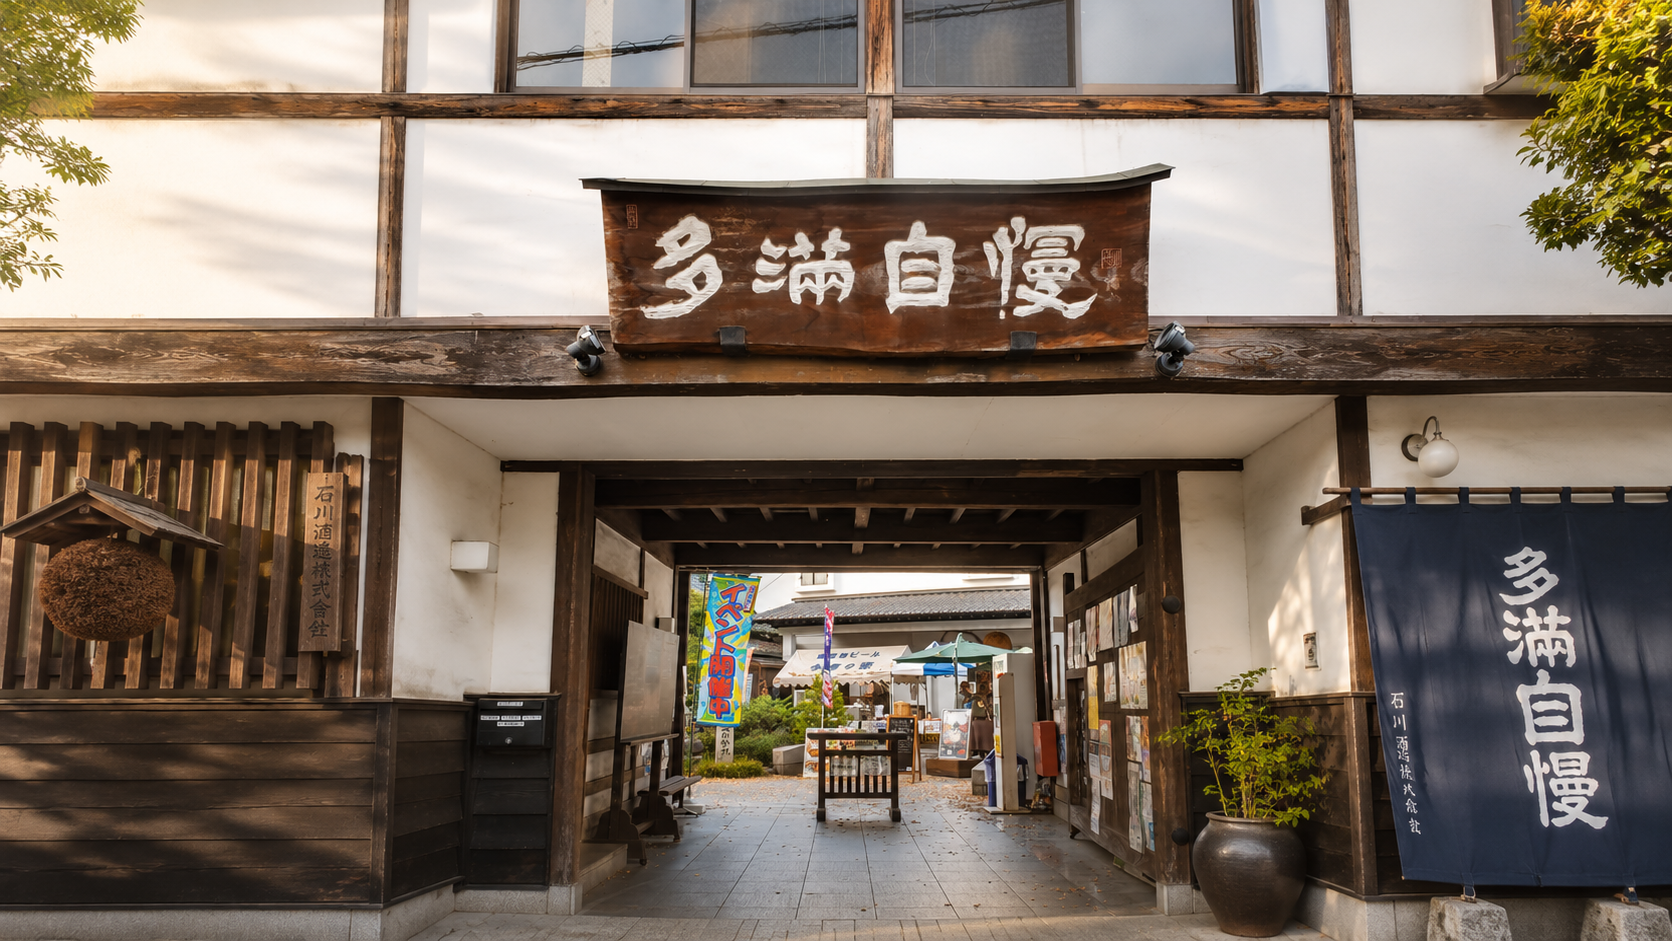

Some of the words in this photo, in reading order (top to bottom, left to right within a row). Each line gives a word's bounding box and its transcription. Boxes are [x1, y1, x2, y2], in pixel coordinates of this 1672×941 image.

[640, 214, 1098, 320] 多満自慢
[1499, 546, 1609, 830] 多満自慢
